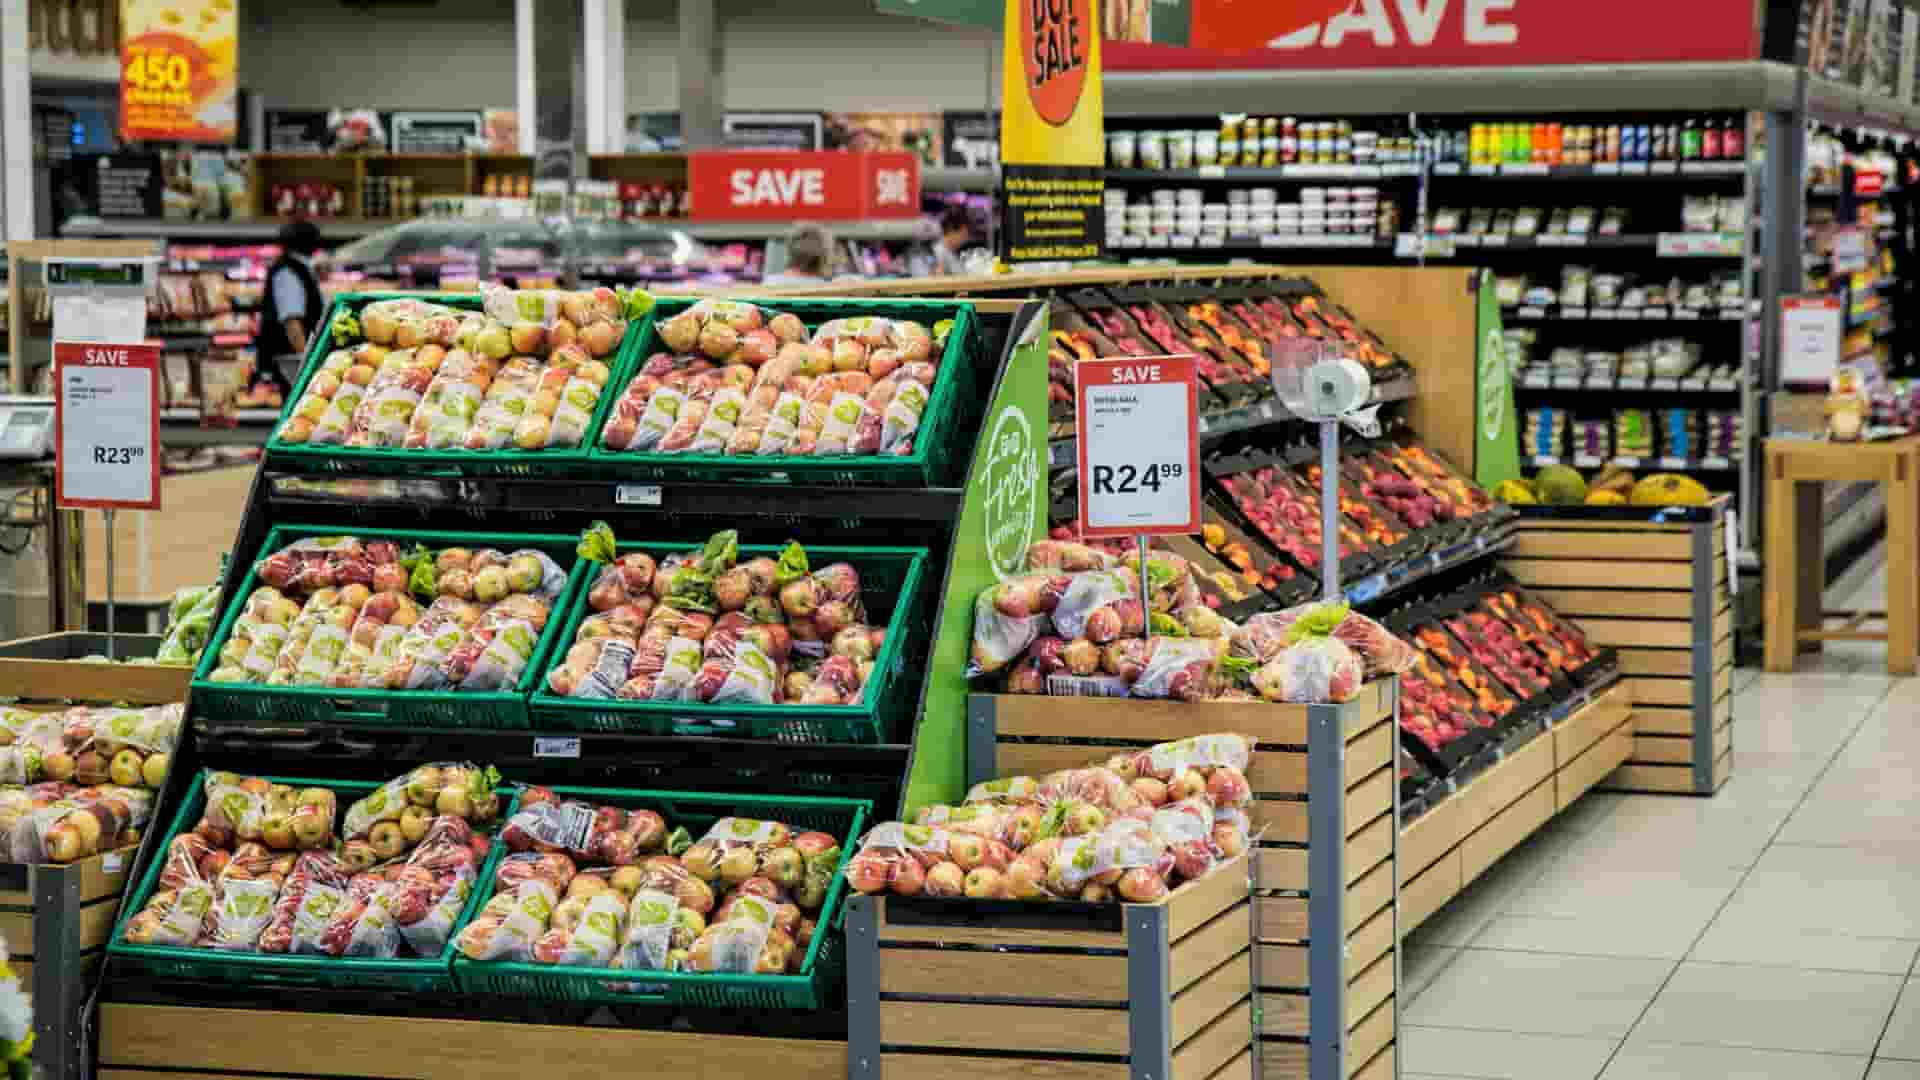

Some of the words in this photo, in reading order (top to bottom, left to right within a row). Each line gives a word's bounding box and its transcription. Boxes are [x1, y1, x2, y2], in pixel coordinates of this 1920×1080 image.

[1034, 17, 1082, 87] SALE
[127, 55, 190, 90] 450
[731, 168, 825, 207] SAVE
[85, 350, 129, 367] SAVE
[1112, 366, 1161, 383] SAVE
